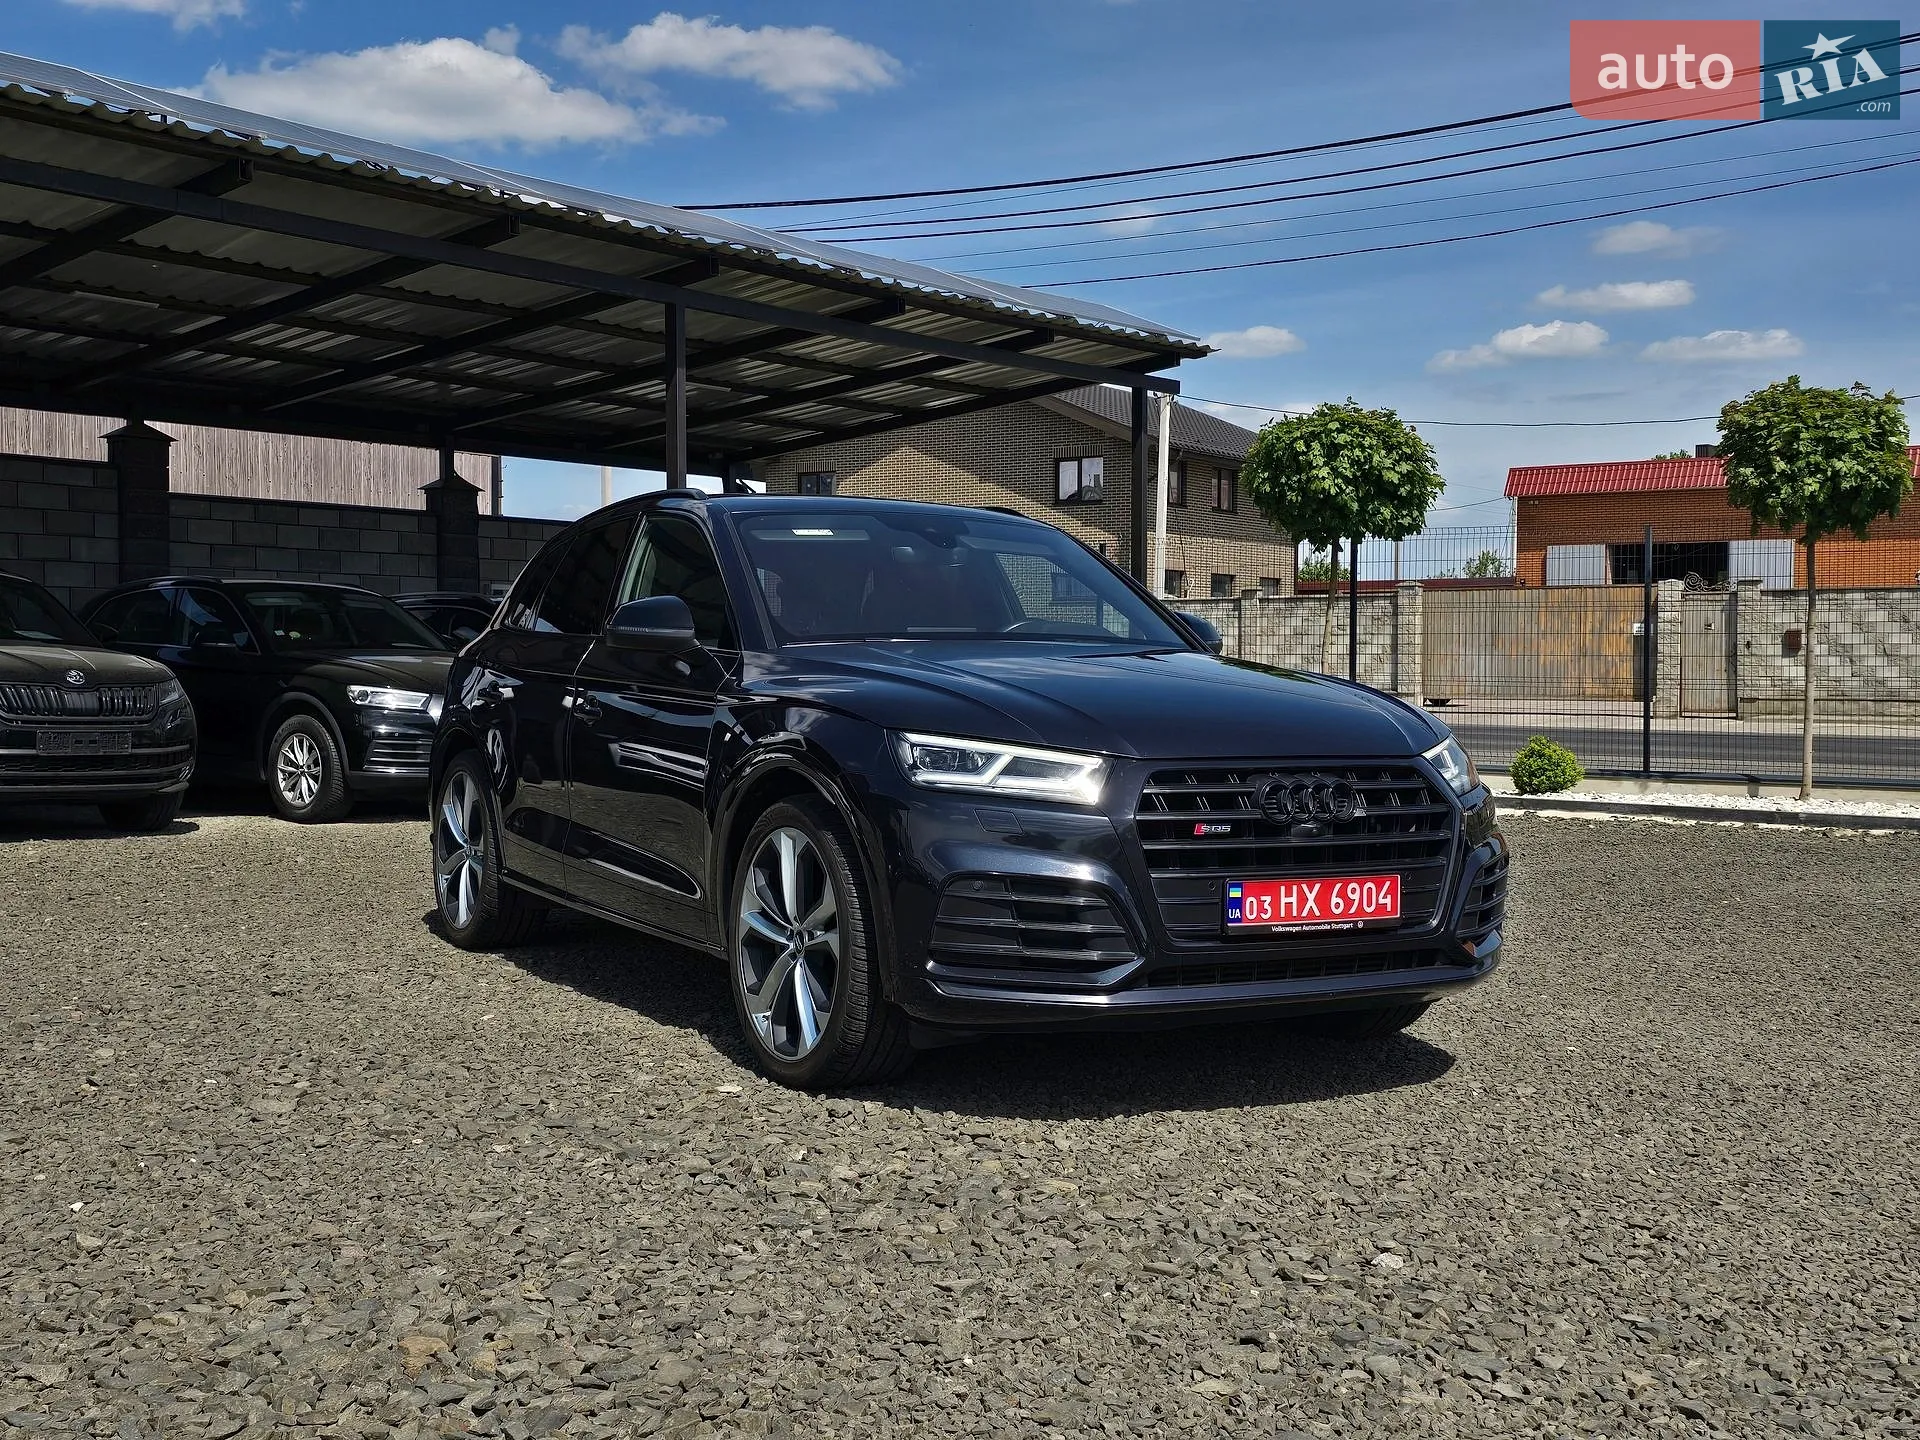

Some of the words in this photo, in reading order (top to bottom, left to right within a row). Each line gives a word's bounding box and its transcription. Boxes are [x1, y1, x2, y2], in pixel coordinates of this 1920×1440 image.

[1201, 824, 1231, 833] SQ5
[1245, 896, 1273, 920] 03
[1280, 883, 1321, 918] HX
[1330, 880, 1392, 915] 6904
[1228, 908, 1241, 919] UA
[1302, 923, 1330, 931] Automobile
[1331, 922, 1354, 930] Stuttgart
